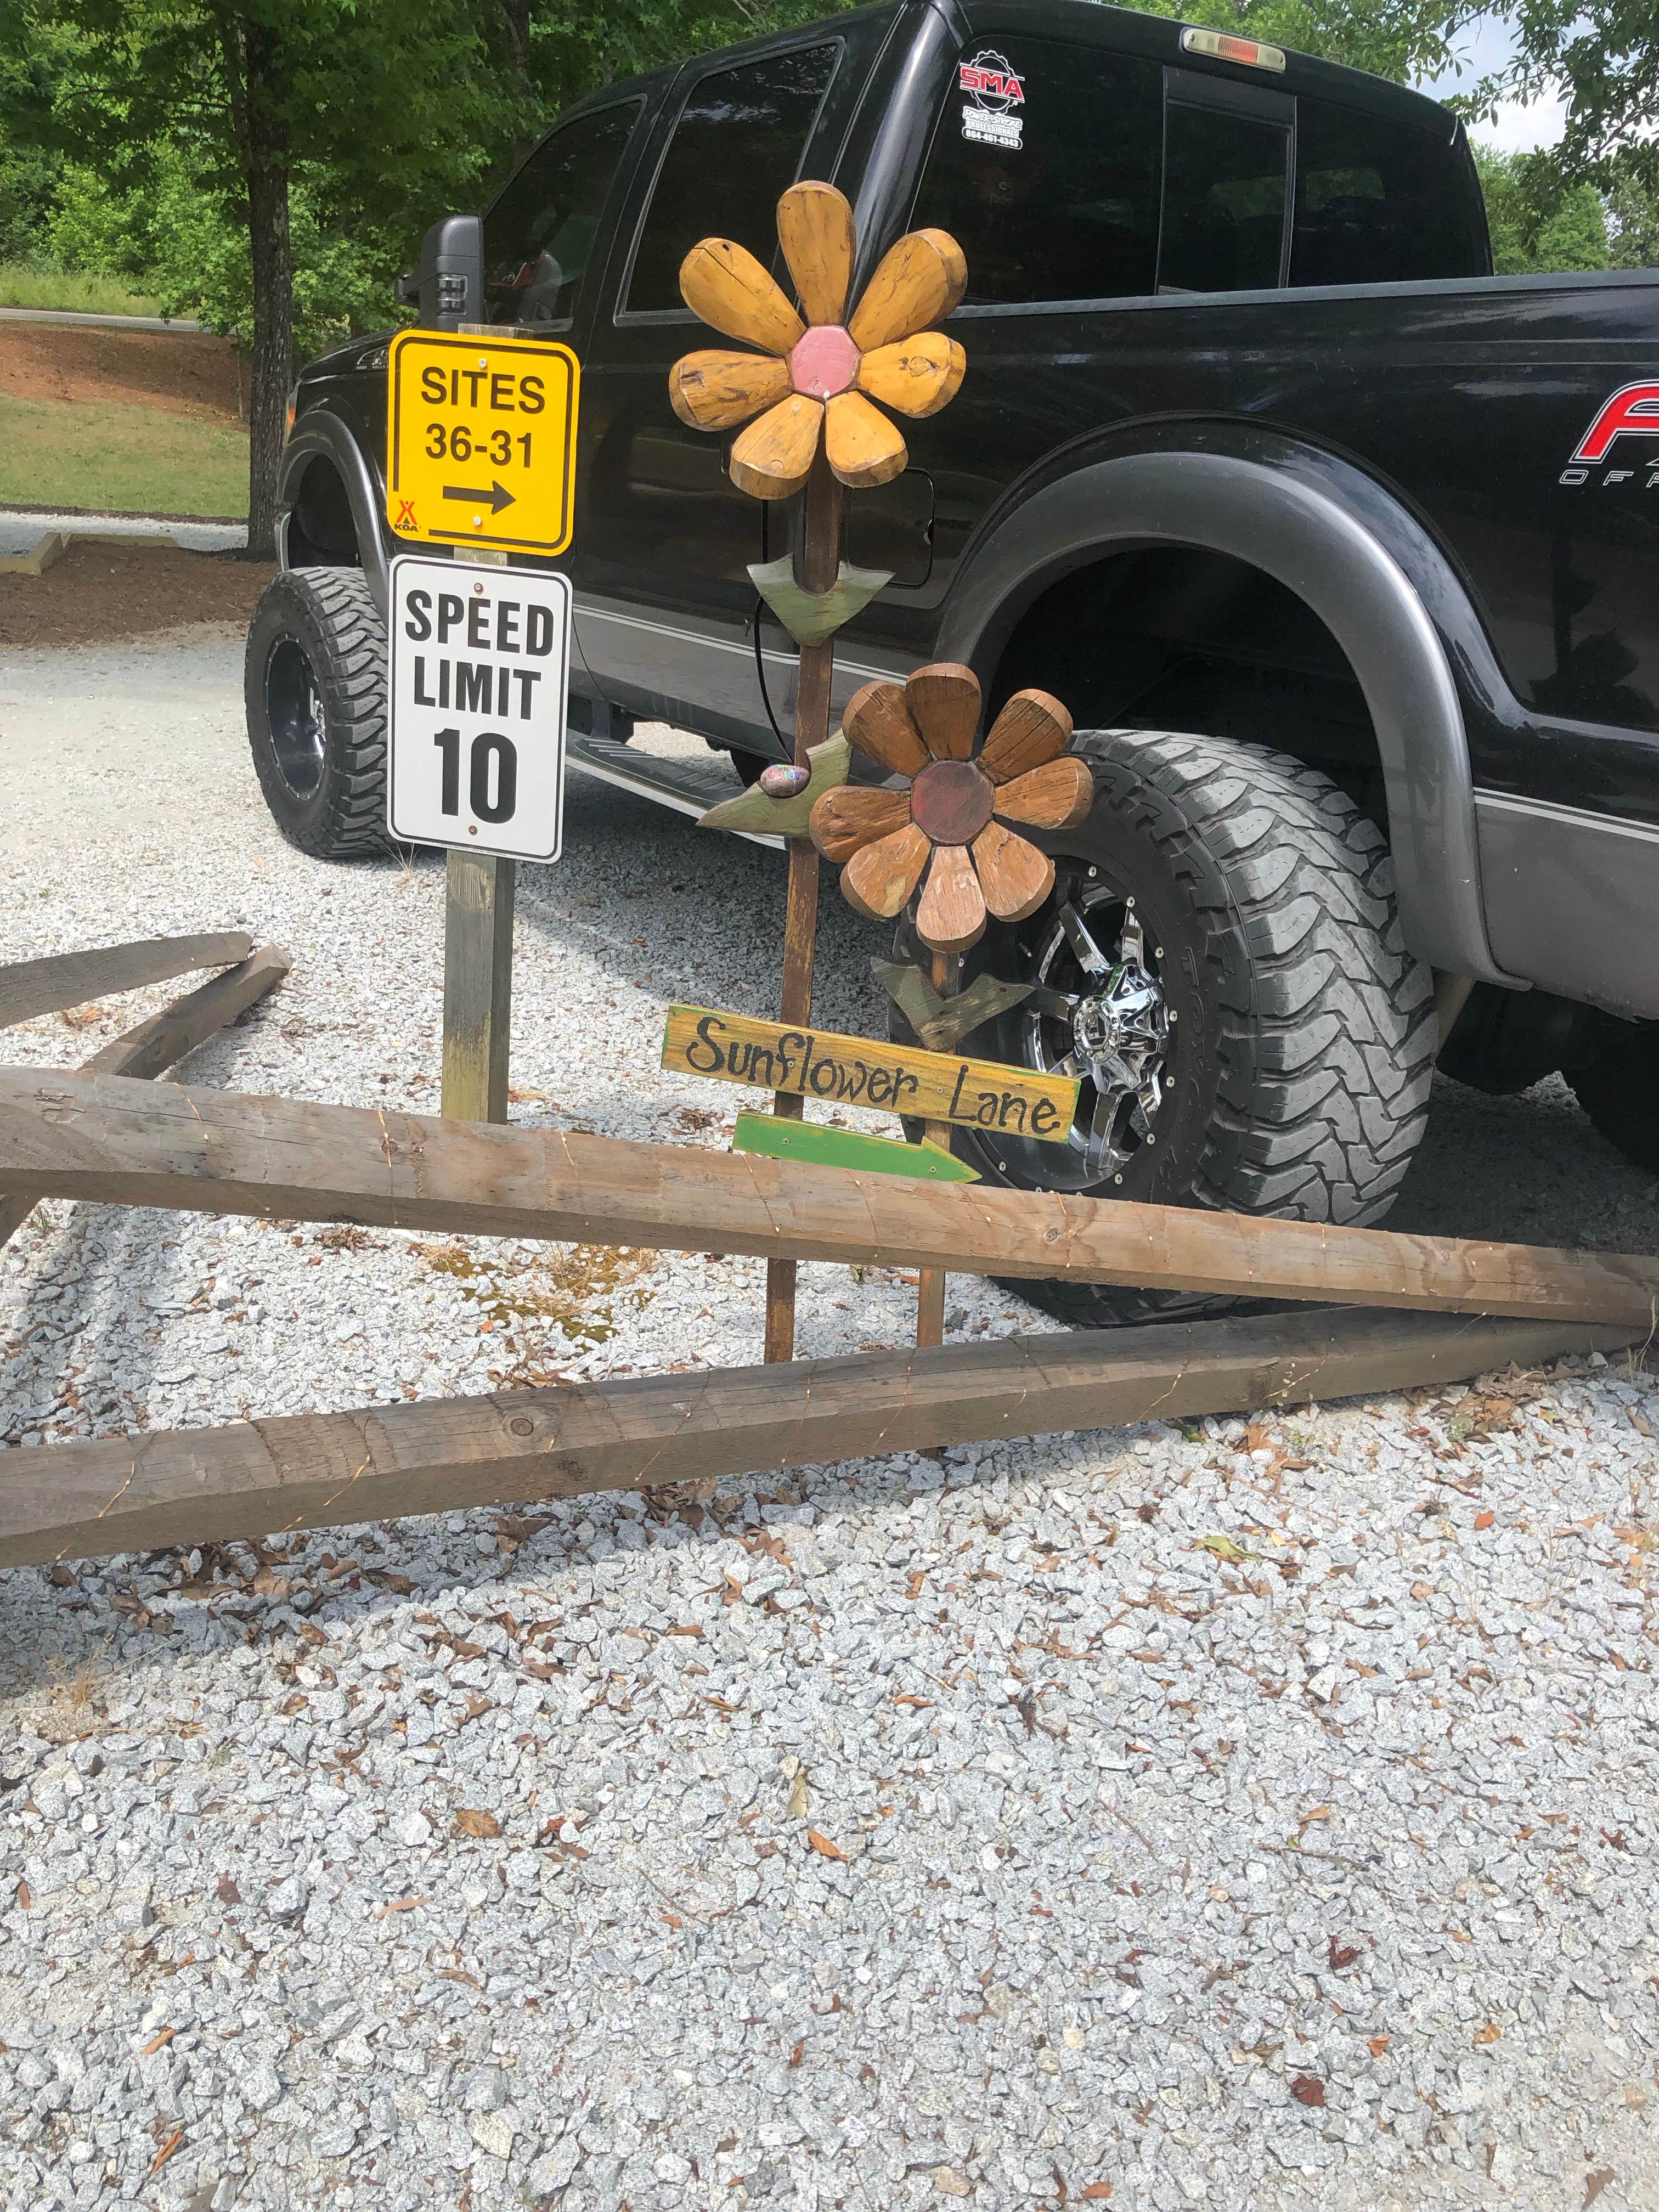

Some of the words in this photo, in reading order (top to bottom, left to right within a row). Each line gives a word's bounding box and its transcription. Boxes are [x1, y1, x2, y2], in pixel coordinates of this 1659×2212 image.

[960, 66, 1025, 100] SMA
[964, 108, 991, 124] POWER
[991, 115, 1023, 129] STROKE
[966, 120, 1019, 137] PROFESSIONALS
[966, 129, 1019, 148] 864-461-4343
[421, 366, 545, 415] SITES
[425, 423, 532, 469] 36-31
[394, 523, 419, 532] KOA
[405, 589, 554, 657] SPEED
[414, 656, 542, 720] LIMIT
[433, 727, 518, 824] 10
[768, 770, 805, 780] Color
[685, 1015, 919, 1109] Sunflower
[949, 1064, 1061, 1135] Lane
